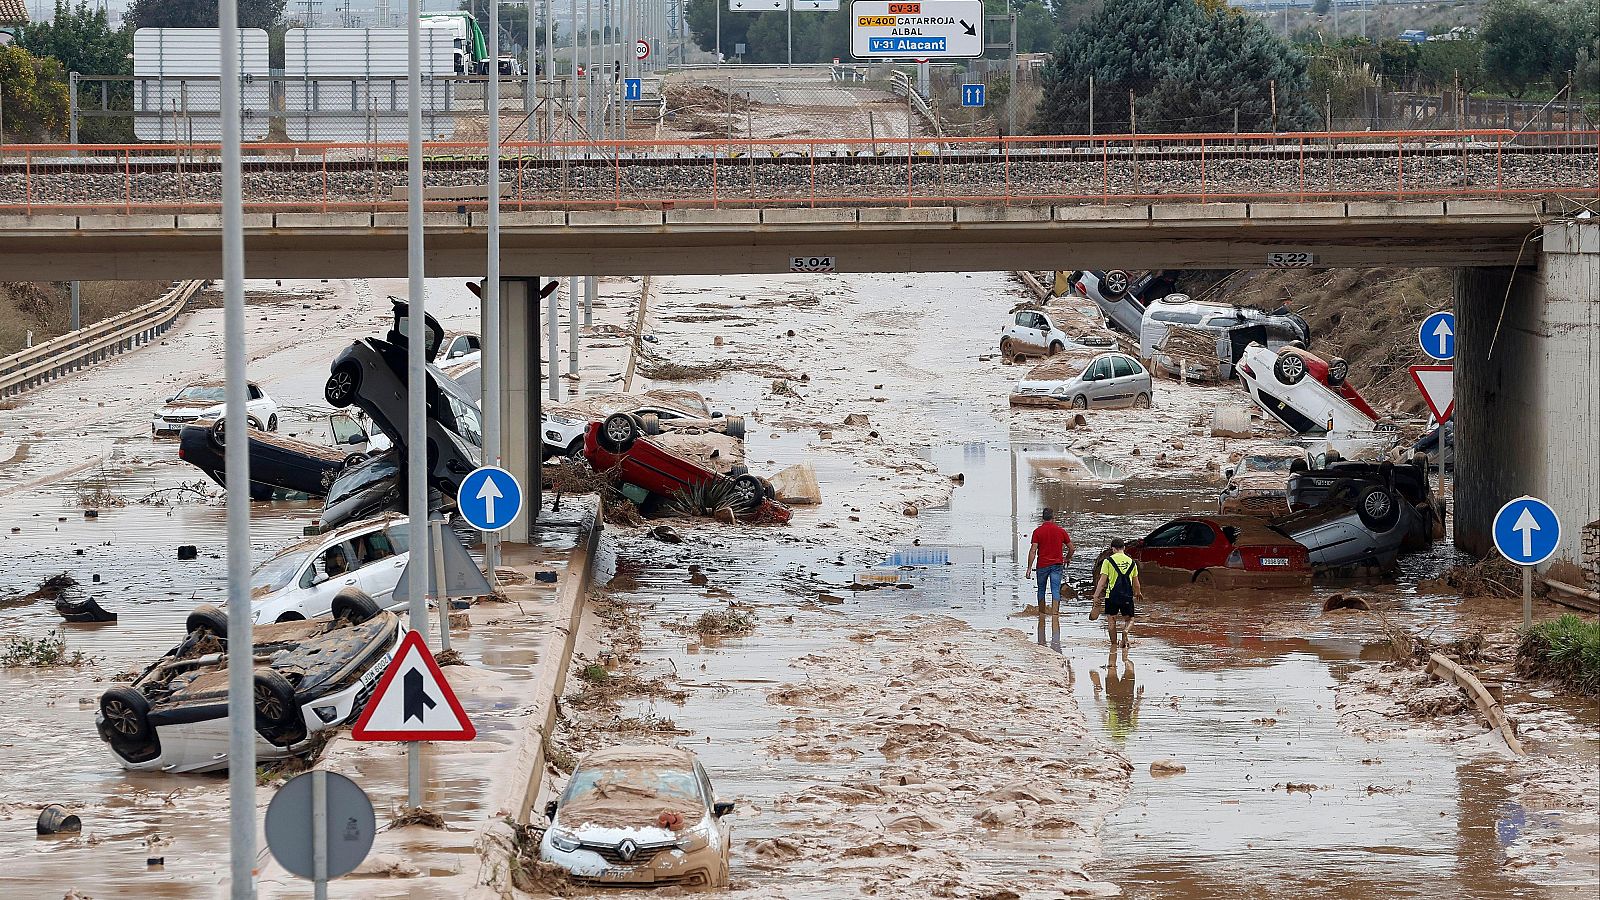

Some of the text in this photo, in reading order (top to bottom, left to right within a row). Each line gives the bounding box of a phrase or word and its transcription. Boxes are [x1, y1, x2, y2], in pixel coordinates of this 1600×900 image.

[890, 4, 919, 13] CV-33
[859, 17, 955, 25] CV-400 CATARROJA
[891, 28, 923, 36] ALBAL
[873, 39, 945, 50] V-31 Alacant
[794, 257, 831, 268] 5.04
[374, 656, 389, 673] 2009
